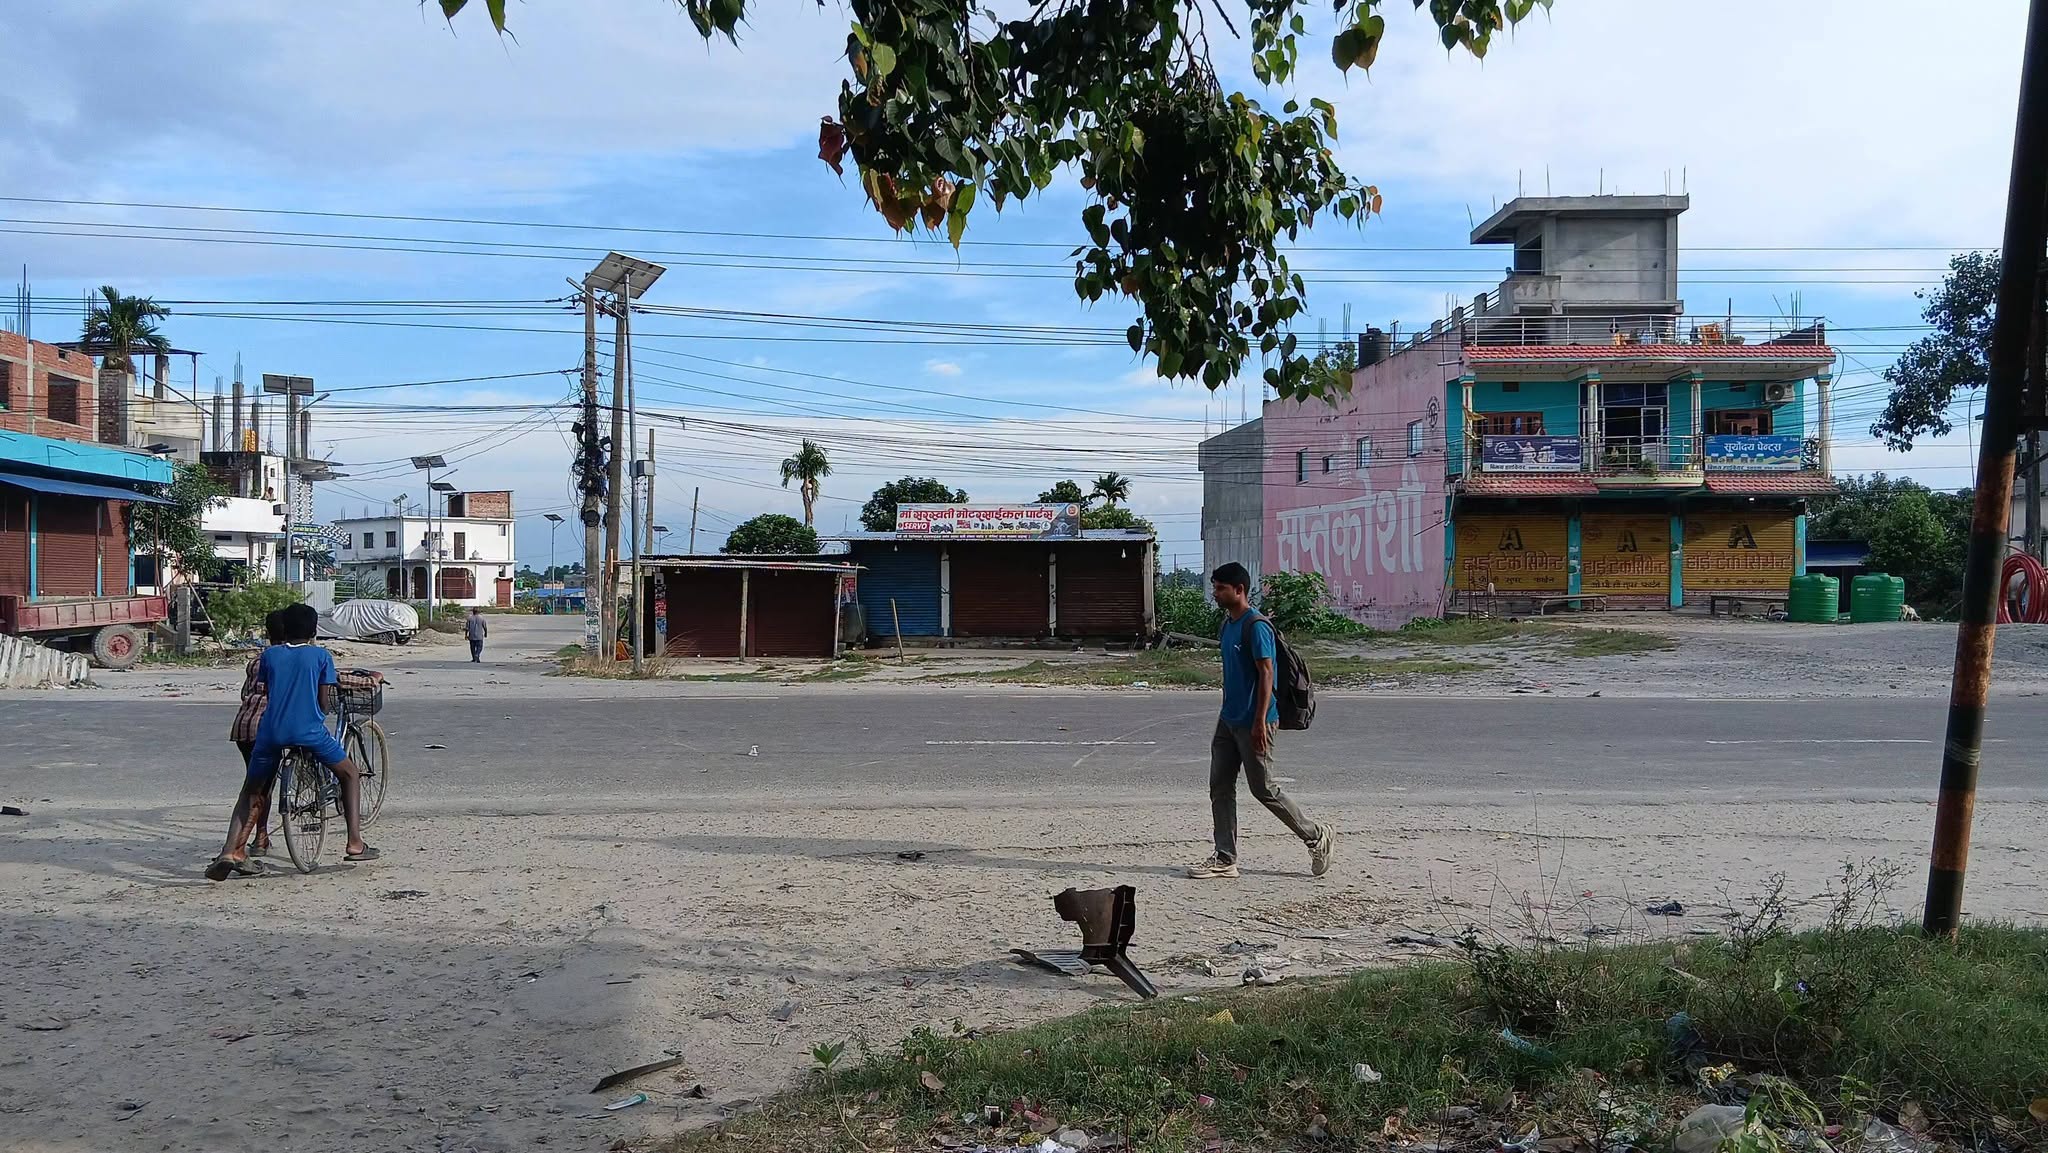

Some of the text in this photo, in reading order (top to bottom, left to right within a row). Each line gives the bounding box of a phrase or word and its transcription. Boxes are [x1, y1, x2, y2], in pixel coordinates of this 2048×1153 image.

[903, 522, 928, 530] SERVO
[913, 508, 954, 521] सरस्वती
[1498, 527, 1523, 550] A
[1616, 529, 1638, 552] A
[1728, 523, 1758, 549] A
